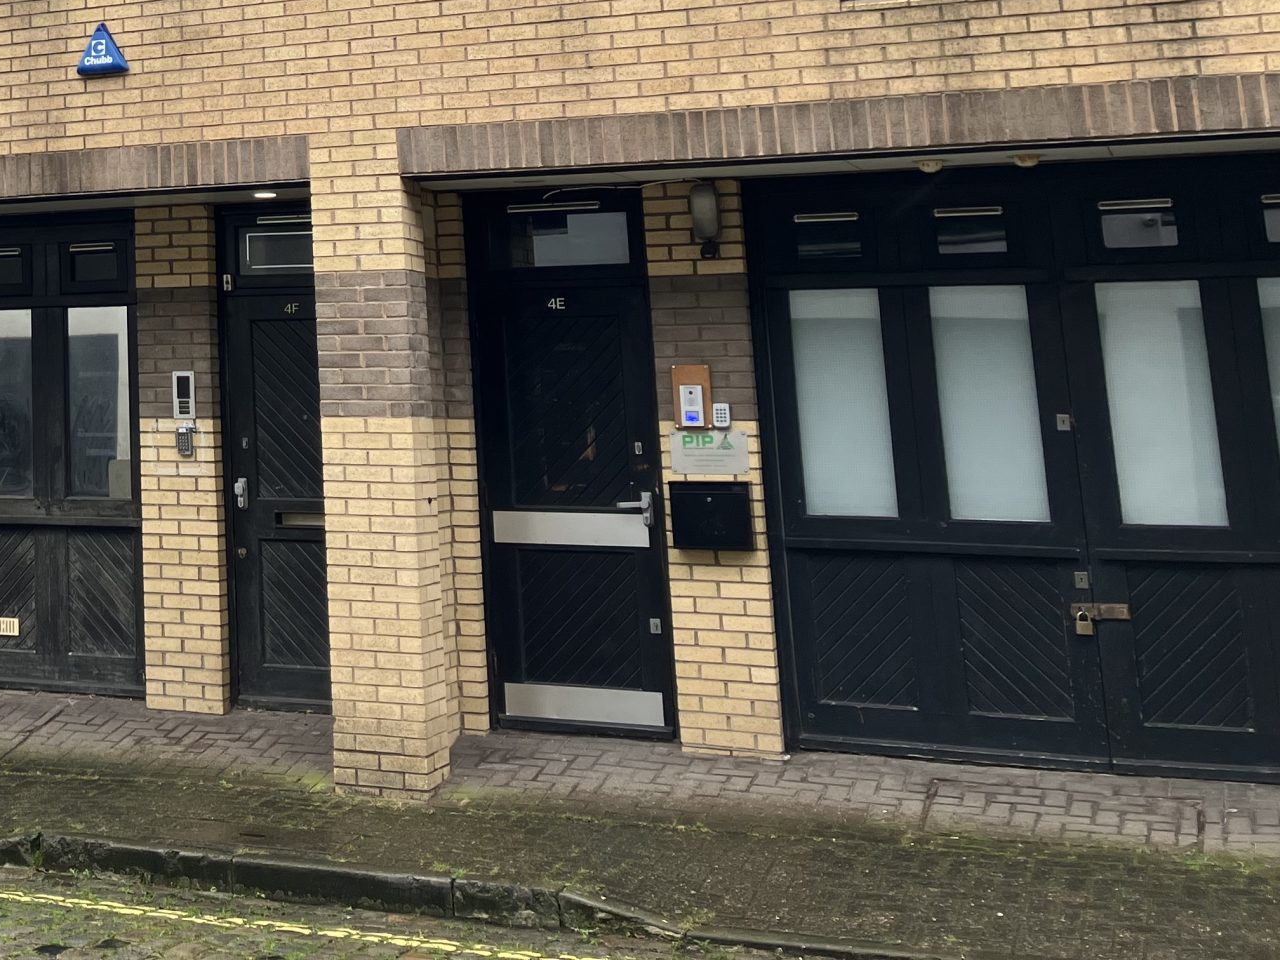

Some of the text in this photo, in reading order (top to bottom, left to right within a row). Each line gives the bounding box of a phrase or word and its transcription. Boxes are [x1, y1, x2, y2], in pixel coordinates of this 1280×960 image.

[84, 55, 113, 65] Chubb
[284, 303, 300, 314] 4F
[547, 297, 566, 310] 4E
[682, 434, 714, 447] PIP
